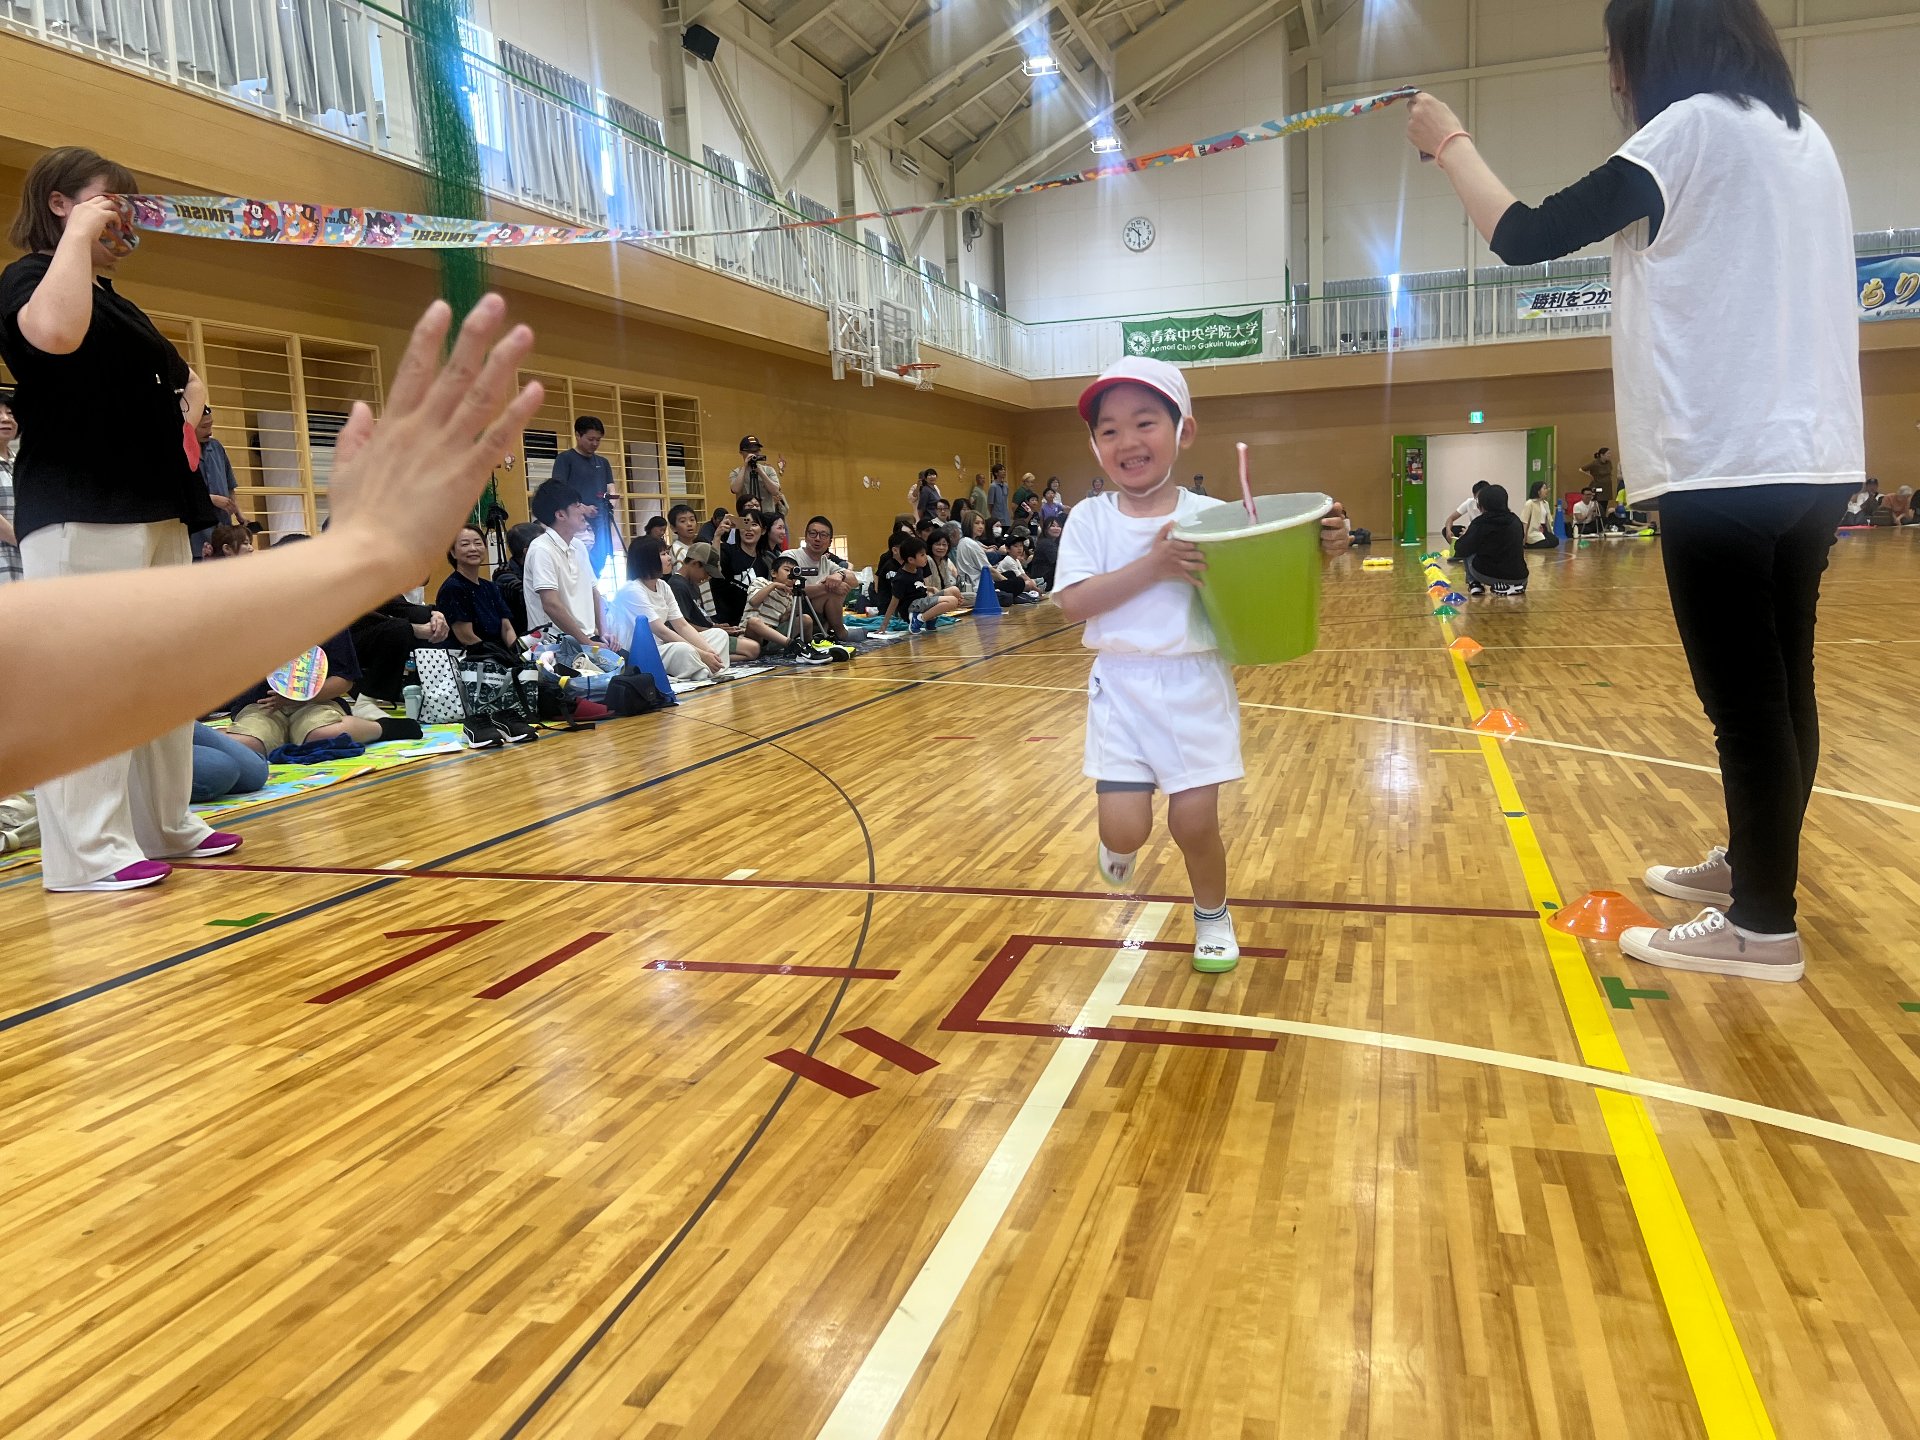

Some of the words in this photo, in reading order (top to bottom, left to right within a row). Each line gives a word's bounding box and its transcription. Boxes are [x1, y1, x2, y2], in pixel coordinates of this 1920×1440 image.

[1150, 320, 1259, 345] 青森中央学院大学
[1150, 343, 1176, 353] Aomori
[1177, 343, 1196, 351] Chuo
[1198, 340, 1224, 350] Gakuin
[1225, 337, 1259, 347] University
